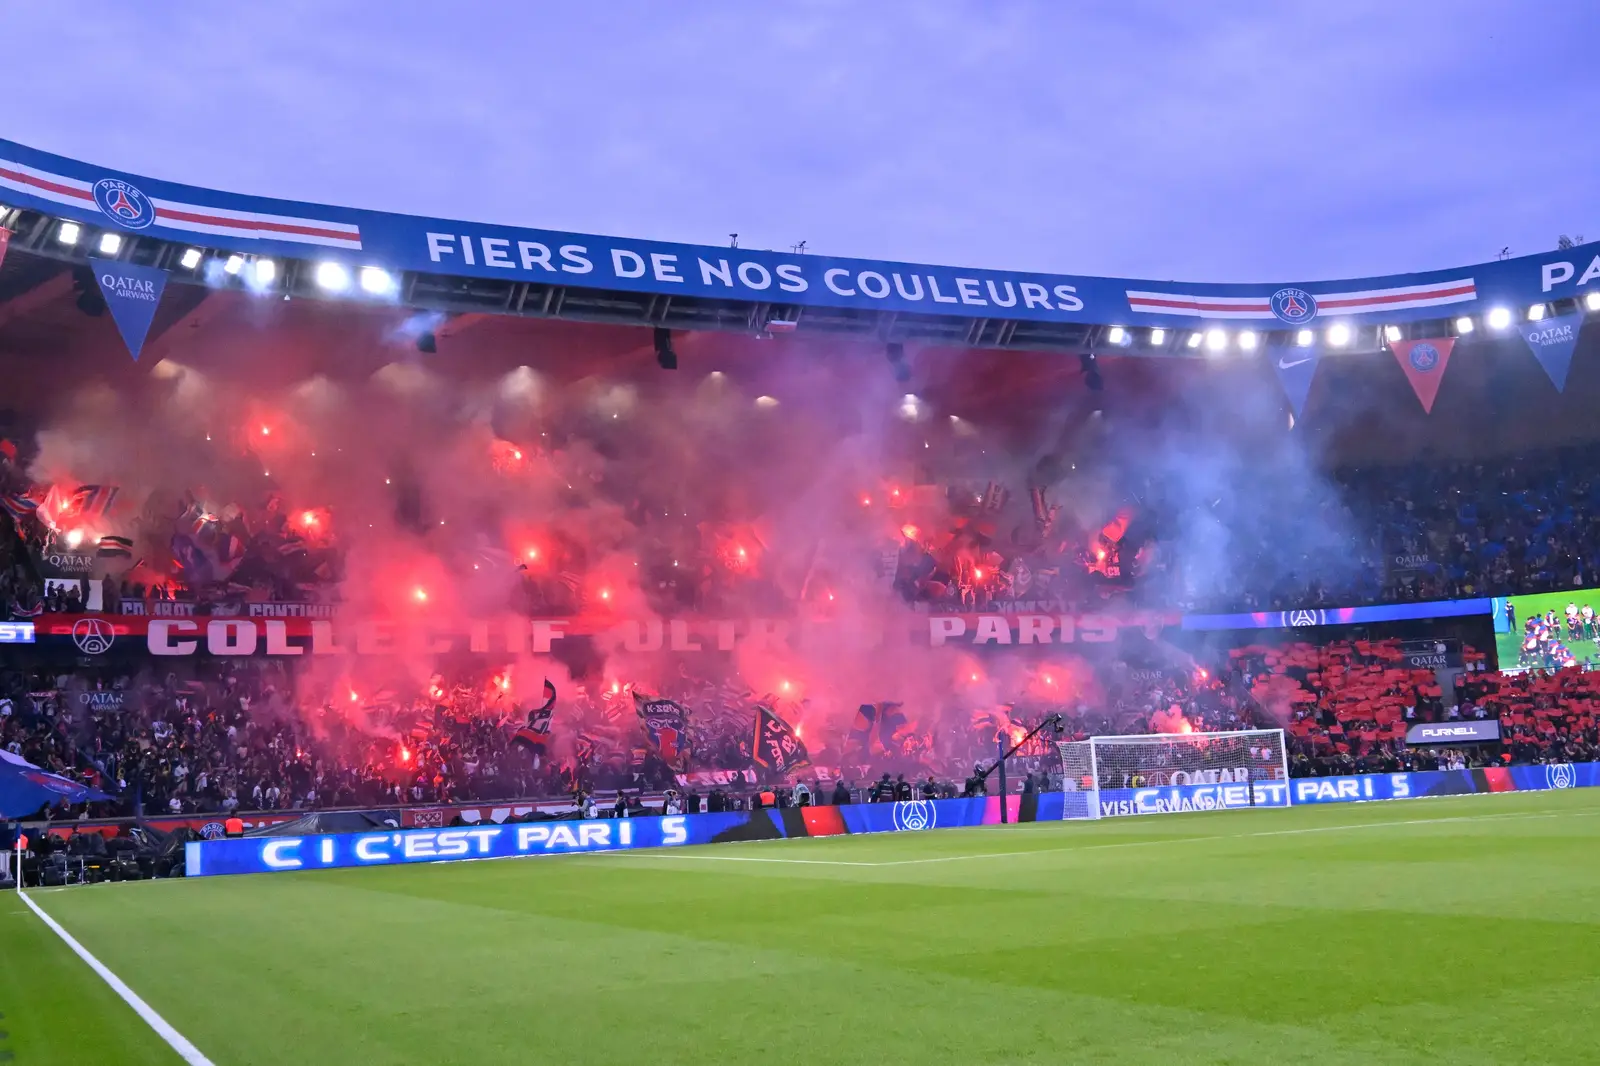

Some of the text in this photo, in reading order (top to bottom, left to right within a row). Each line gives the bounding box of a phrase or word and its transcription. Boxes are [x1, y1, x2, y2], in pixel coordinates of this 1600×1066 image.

[101, 181, 140, 198] PARIS
[426, 232, 1084, 312] FIERS DE NOS COULEURS
[101, 274, 154, 293] QATAR
[116, 289, 156, 302] AIRWAYS
[1276, 290, 1305, 300] PARIS
[1528, 325, 1572, 344] QATAR
[1540, 335, 1574, 347] AIRWAYS
[50, 555, 92, 567] QATAR
[929, 615, 1119, 647] PARIS
[1410, 655, 1446, 667] QATAR
[1422, 727, 1477, 737] PURNELL
[1170, 767, 1249, 787] QATAR
[1101, 795, 1227, 816] VISIT RWANDA
[202, 824, 224, 834] PARIS
[356, 830, 502, 860] C'EST
